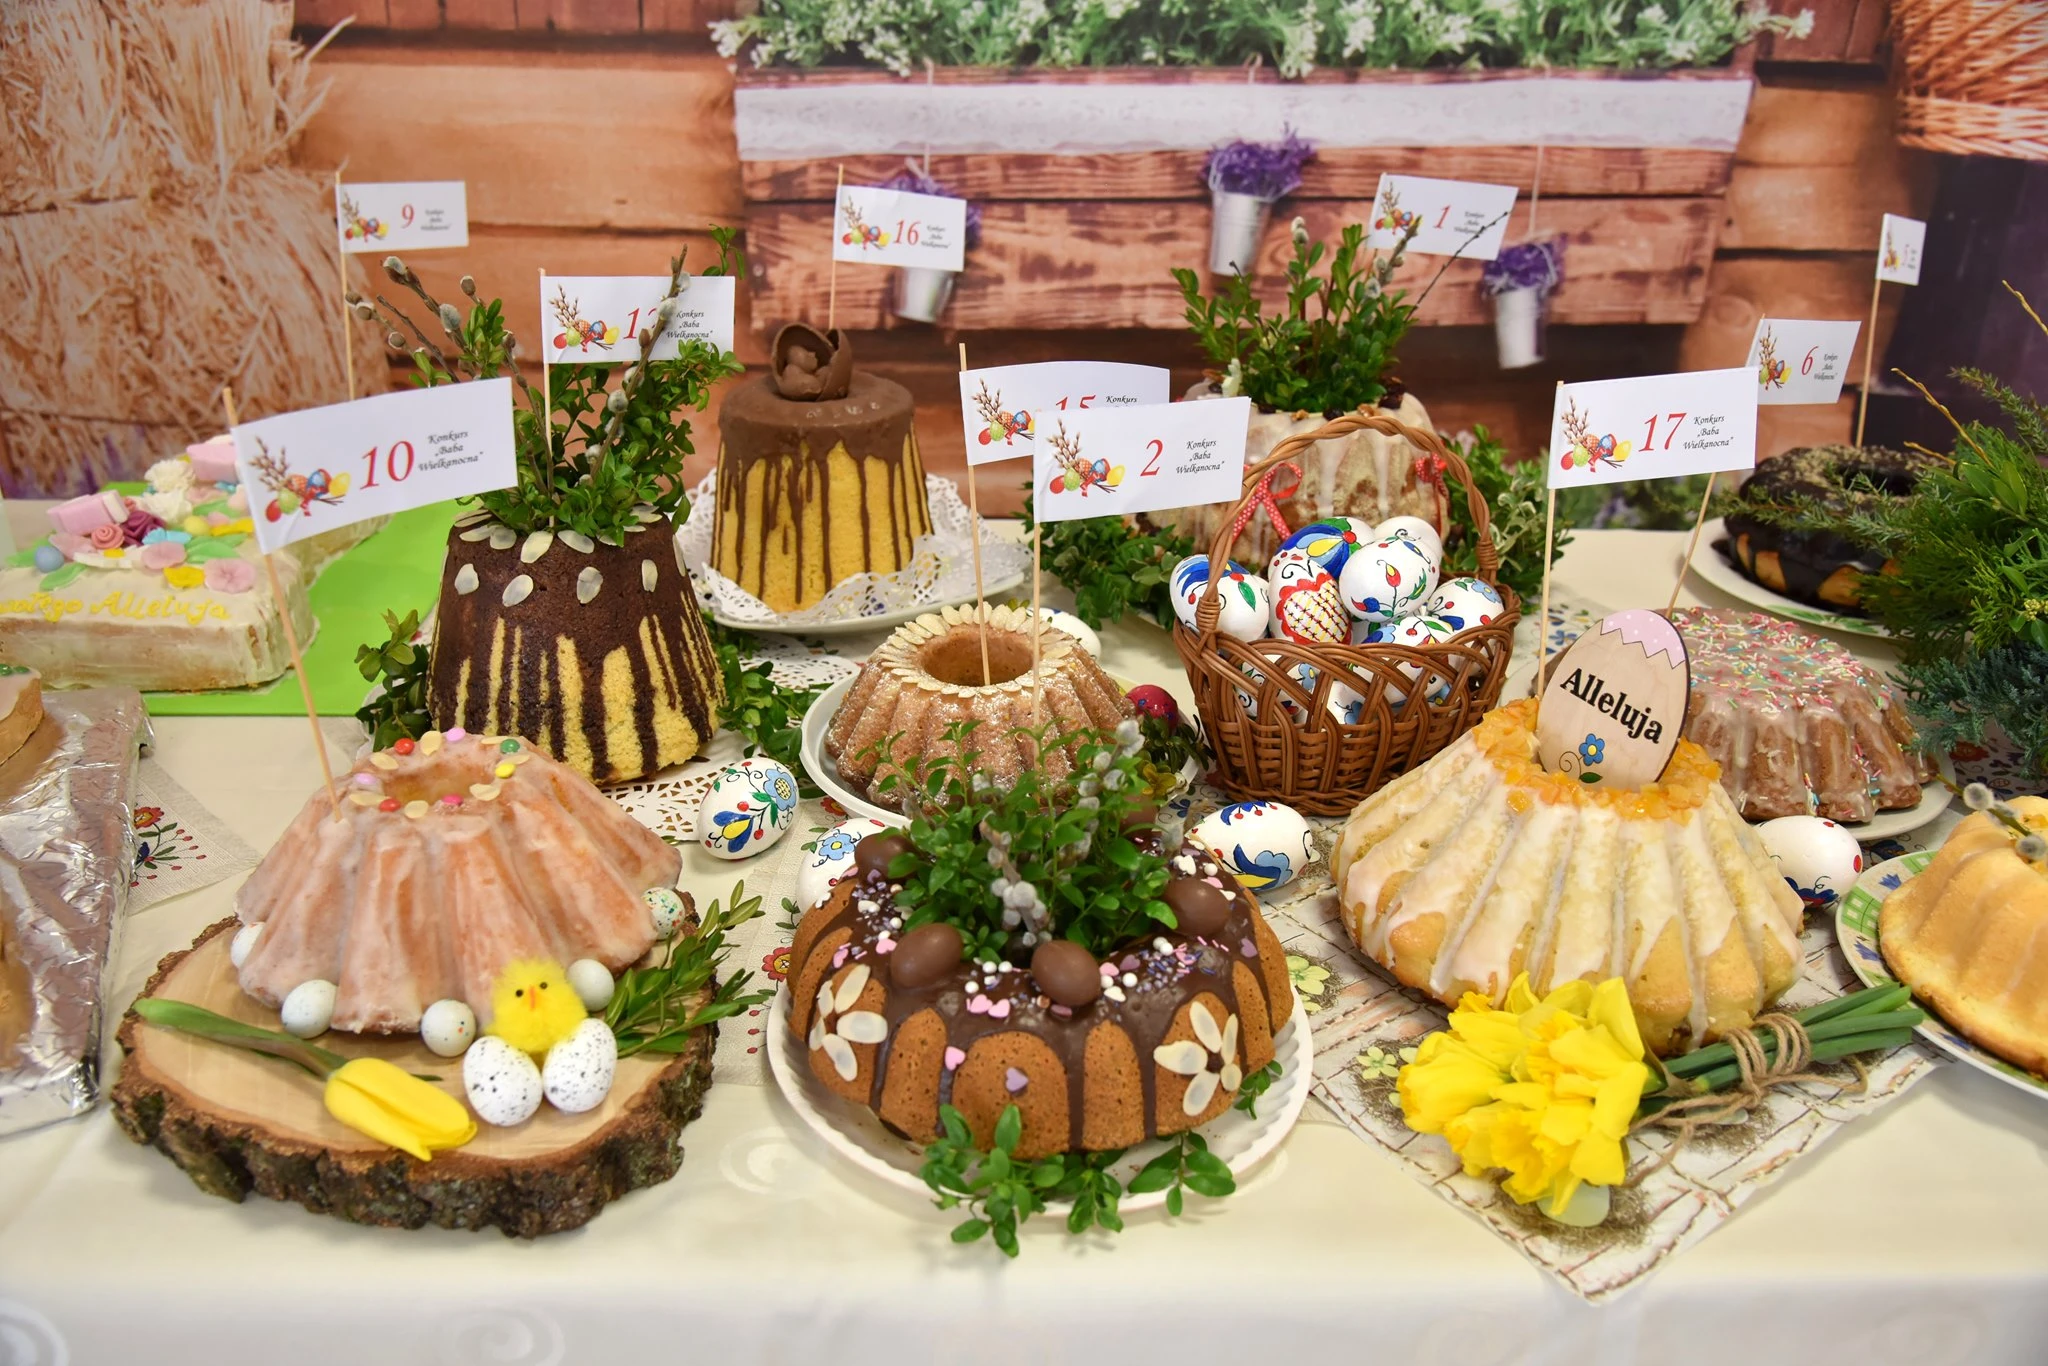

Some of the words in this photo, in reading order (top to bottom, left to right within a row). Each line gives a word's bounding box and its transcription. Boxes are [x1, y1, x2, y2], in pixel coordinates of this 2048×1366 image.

[401, 203, 414, 229] 9
[1433, 204, 1450, 228] 1
[893, 220, 921, 246] 16
[676, 310, 704, 319] Konkurs
[1802, 345, 1819, 375] 6
[1105, 395, 1138, 404] Konkurs
[1639, 413, 1687, 452] 17
[1694, 414, 1725, 425] Konkurs
[427, 430, 469, 444] Konkurs
[1186, 438, 1217, 450] Konkurs
[359, 440, 415, 490] 10
[1140, 439, 1163, 477] 2
[90, 590, 230, 626] Alleluja
[1560, 667, 1663, 744] Alleluja
